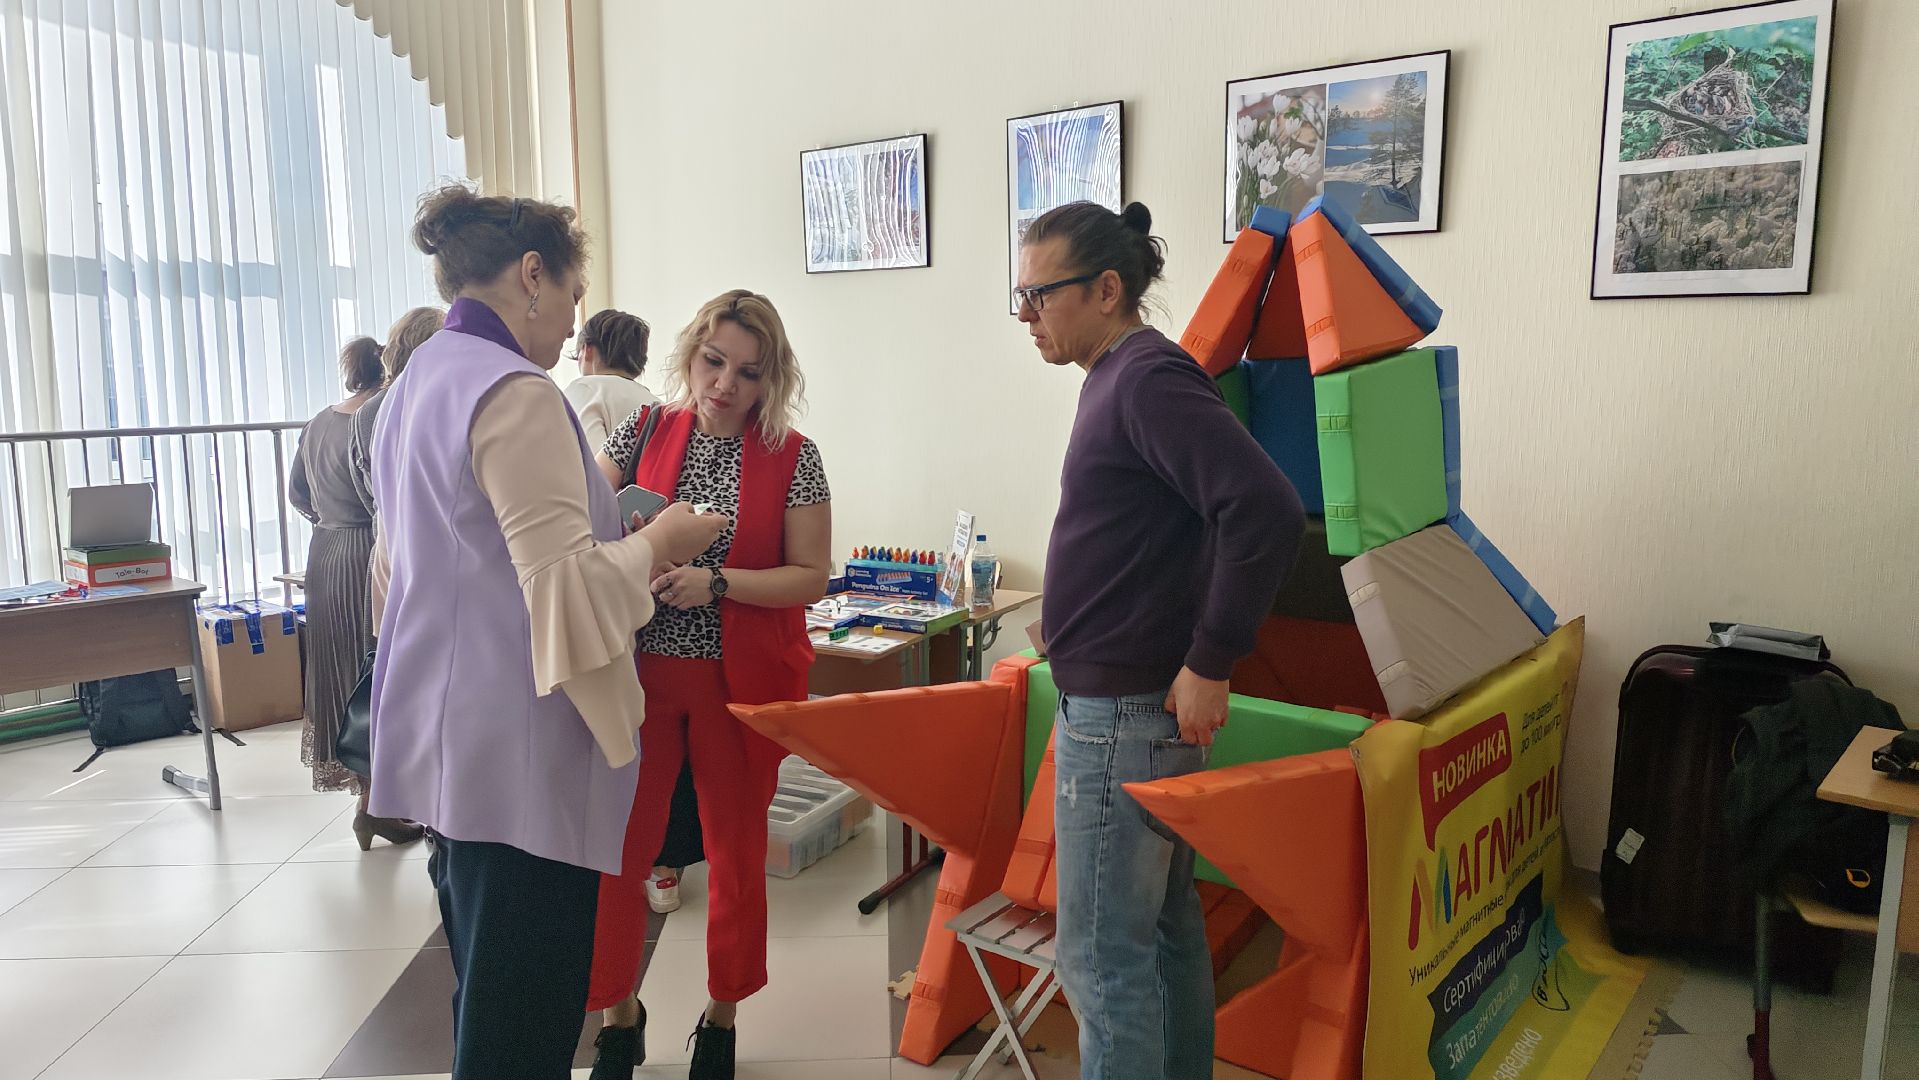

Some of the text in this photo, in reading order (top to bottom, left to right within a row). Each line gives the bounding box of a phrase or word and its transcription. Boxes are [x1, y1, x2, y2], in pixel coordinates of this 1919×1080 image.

[851, 581, 879, 591] Penguins
[880, 584, 889, 592] On
[890, 585, 900, 593] Ice
[1432, 729, 1507, 804] НОВИНКА
[1408, 893, 1504, 987] Уникальные магнитные
